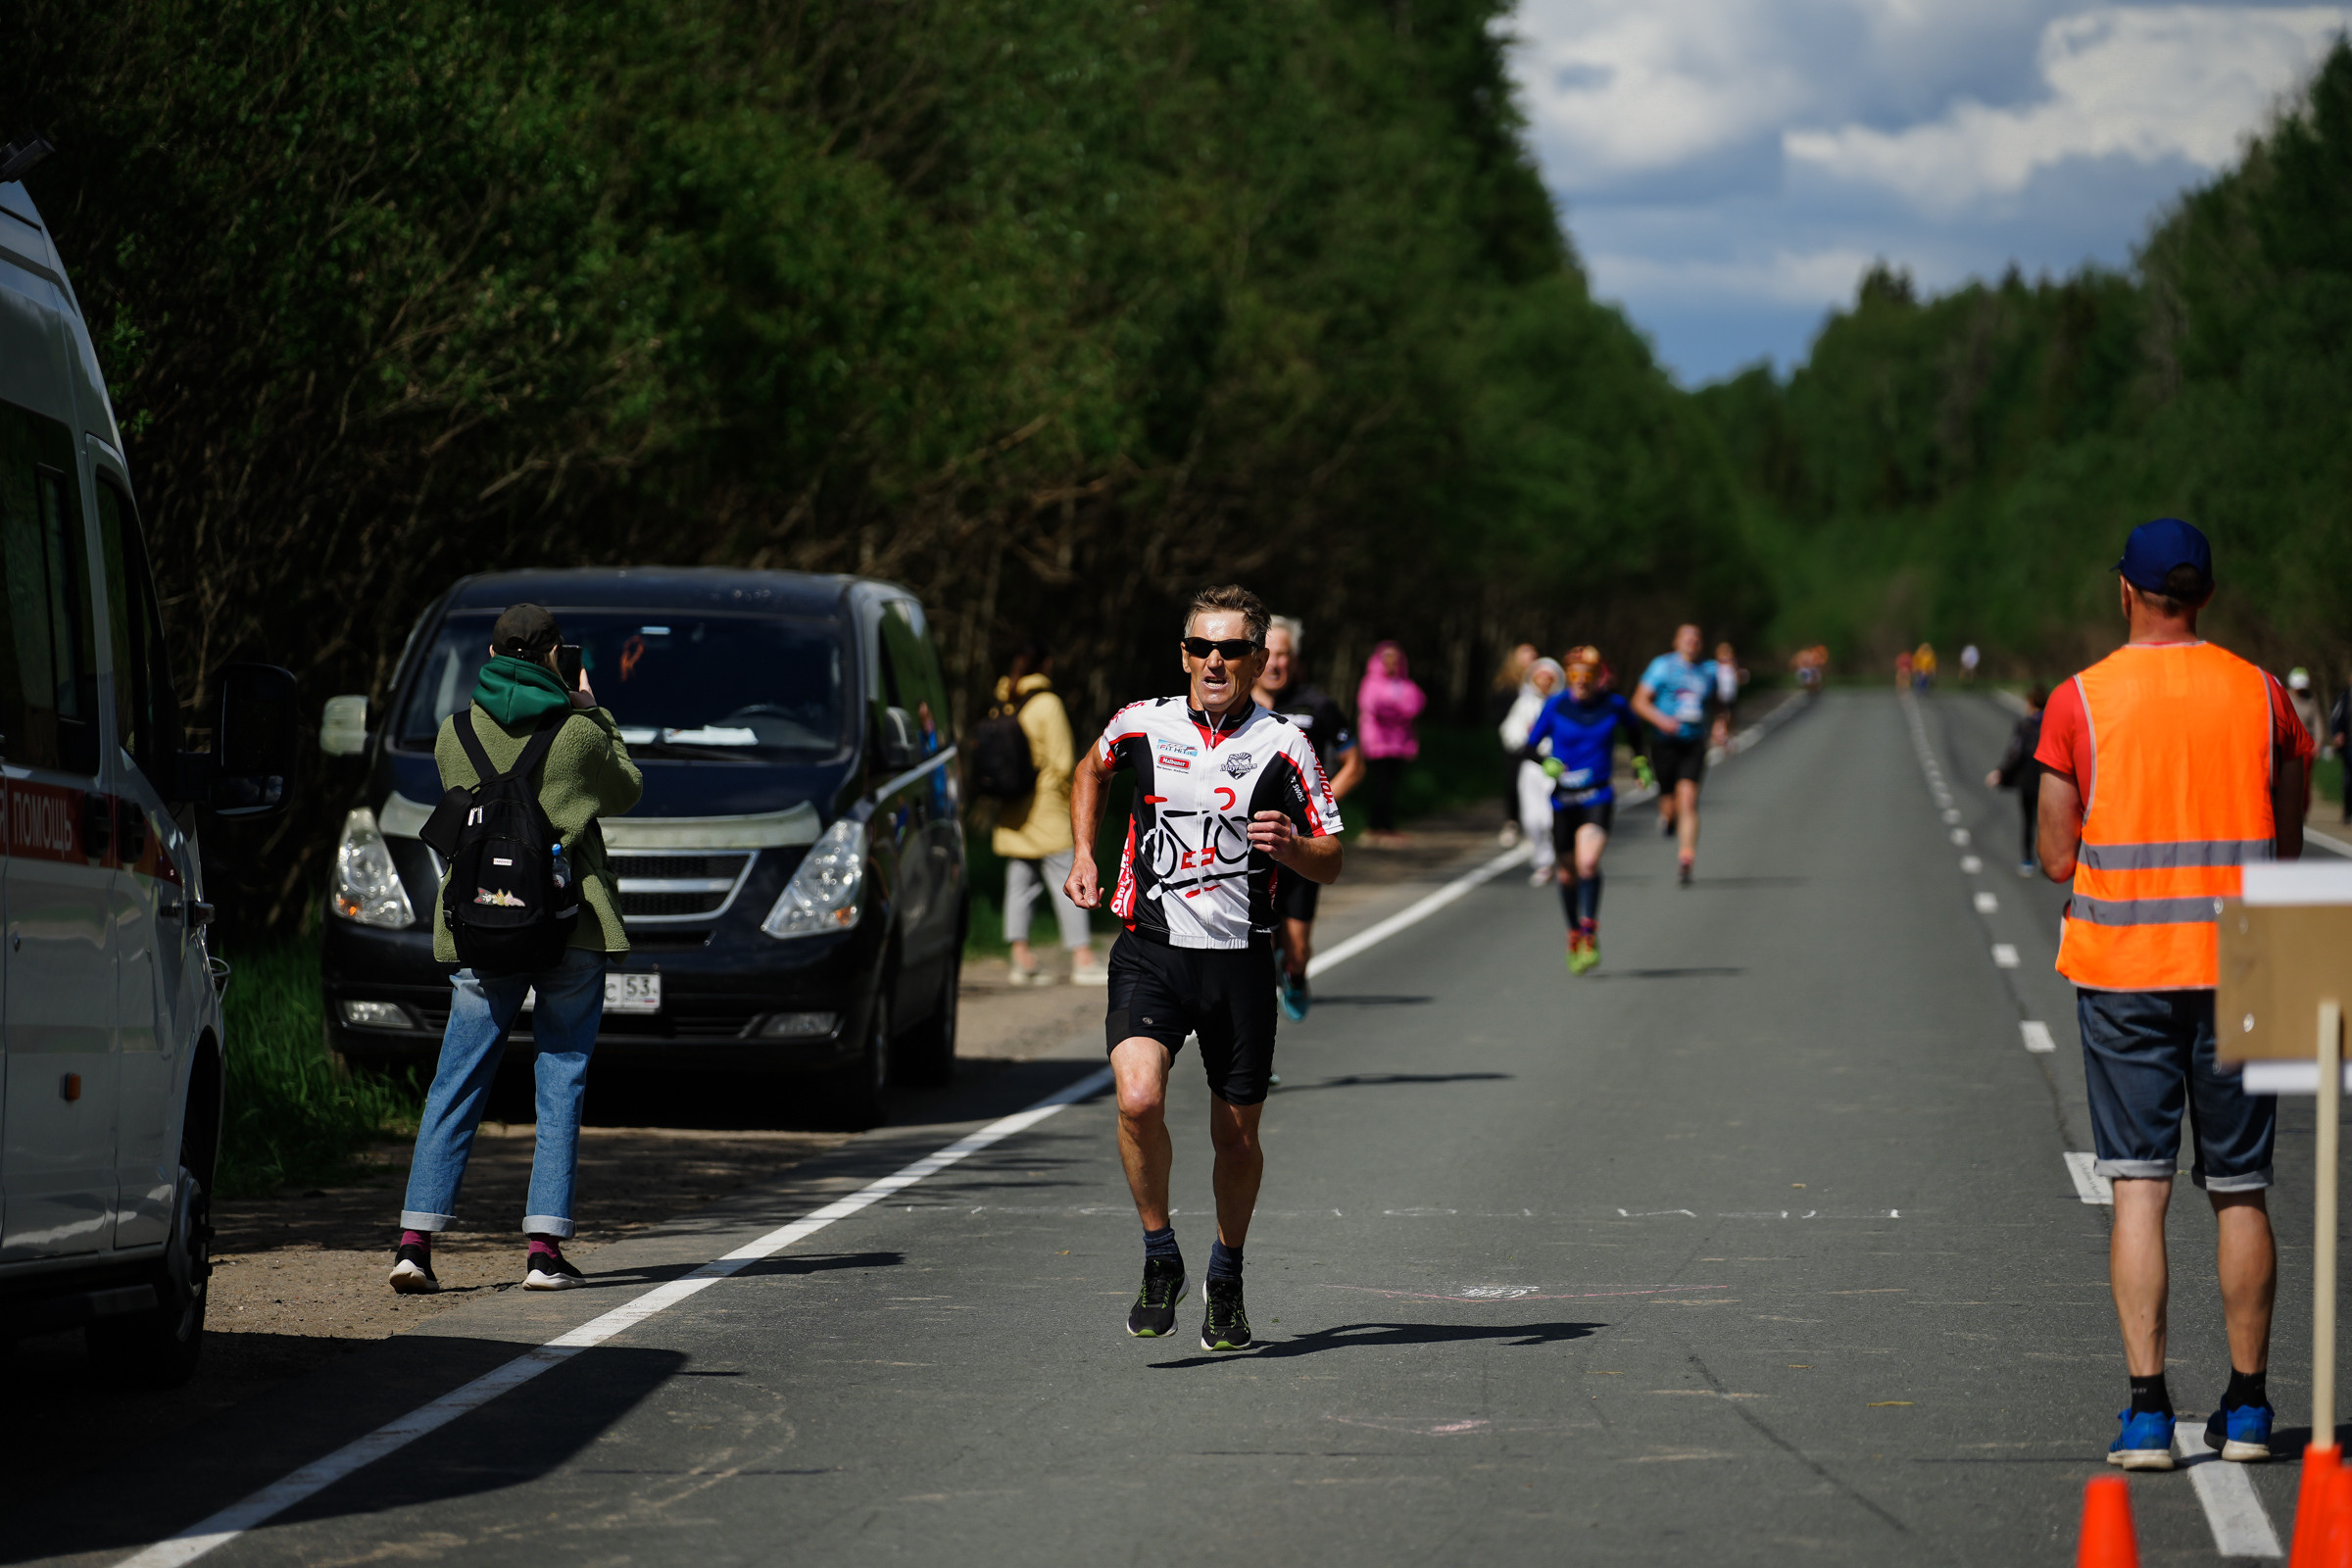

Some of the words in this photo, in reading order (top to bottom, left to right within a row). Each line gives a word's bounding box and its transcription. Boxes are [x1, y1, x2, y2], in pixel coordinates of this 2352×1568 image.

[1292, 783, 1305, 803] SWISS
[13, 791, 73, 859] ПОМОЩЬ
[626, 975, 650, 996] 53
